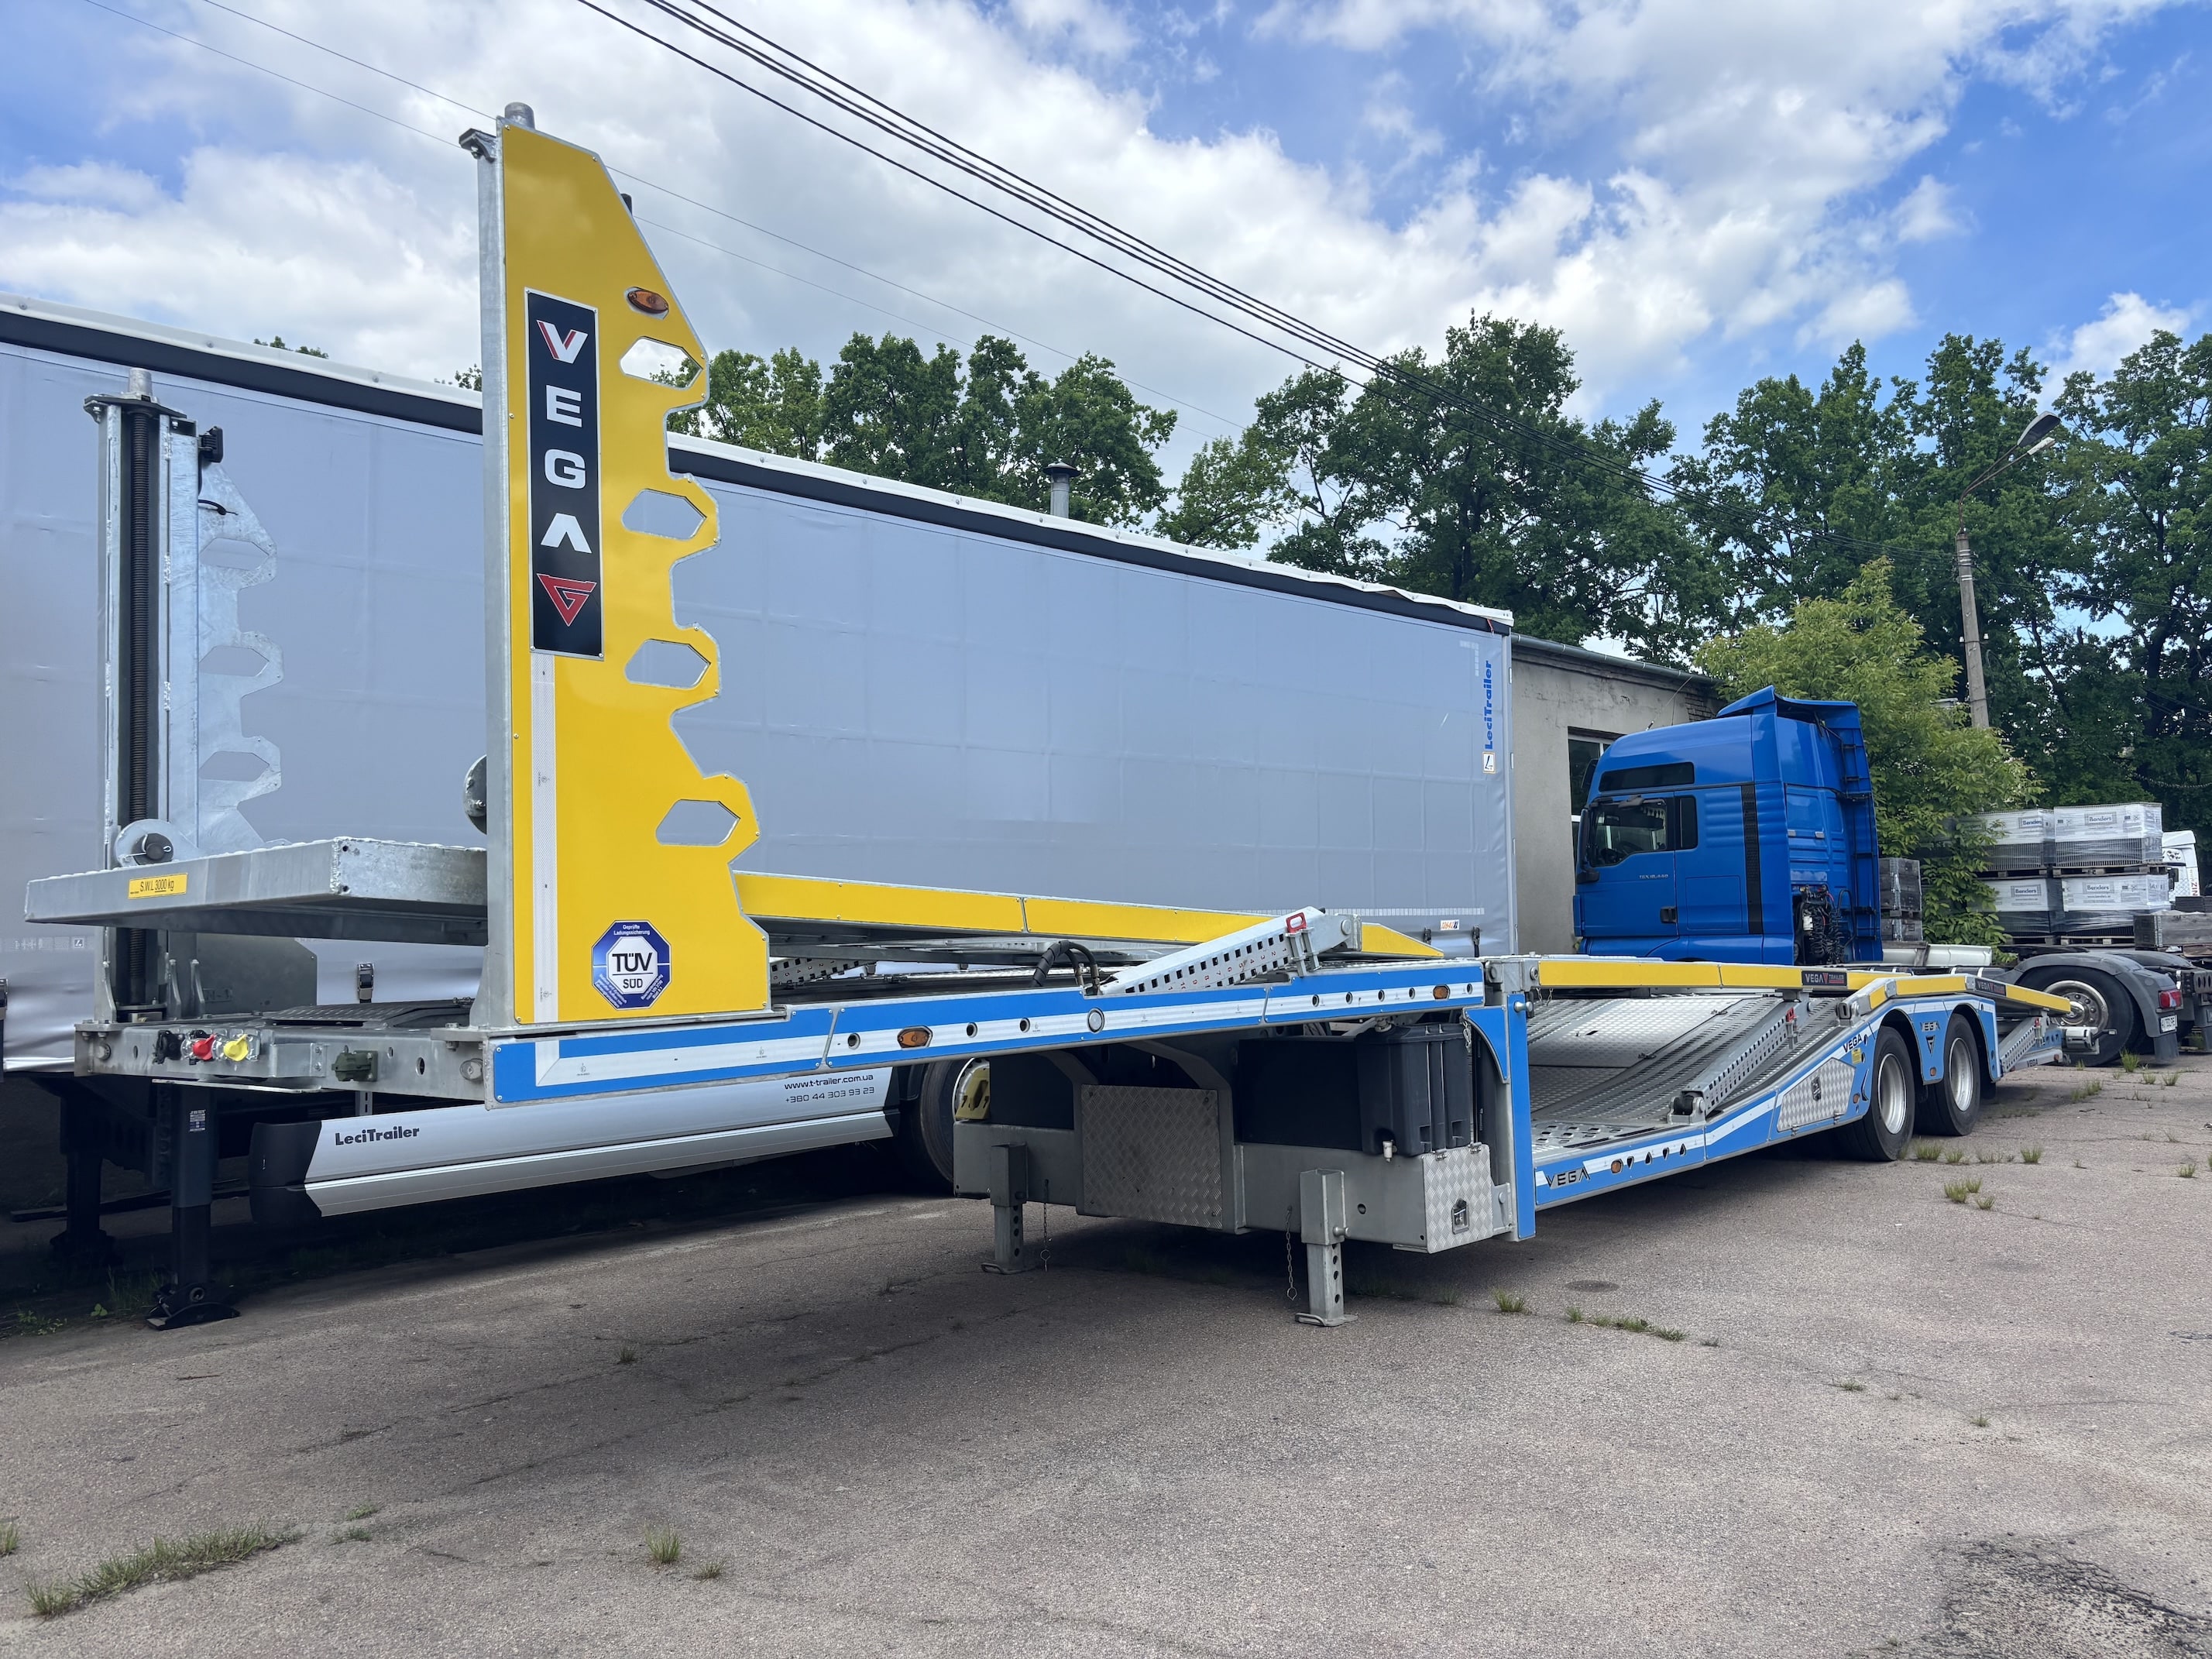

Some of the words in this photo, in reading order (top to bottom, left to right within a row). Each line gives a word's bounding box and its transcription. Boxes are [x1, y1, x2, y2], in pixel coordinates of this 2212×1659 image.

[536, 320, 592, 554] VEGA
[1484, 661, 1493, 750] LeciTrailer
[155, 878, 167, 891] 3000
[167, 878, 174, 891] kg
[612, 952, 653, 972] TÜV
[623, 978, 644, 989] SÜD
[1805, 973, 1824, 983] VEGA
[1843, 1034, 1862, 1053] VEGA
[784, 1074, 874, 1090] www.t-trailer.com.ua
[785, 1094, 809, 1103] +380
[828, 1090, 846, 1098] 303
[335, 1126, 420, 1146] LeciTrailer
[1545, 1166, 1591, 1188] VEGA
